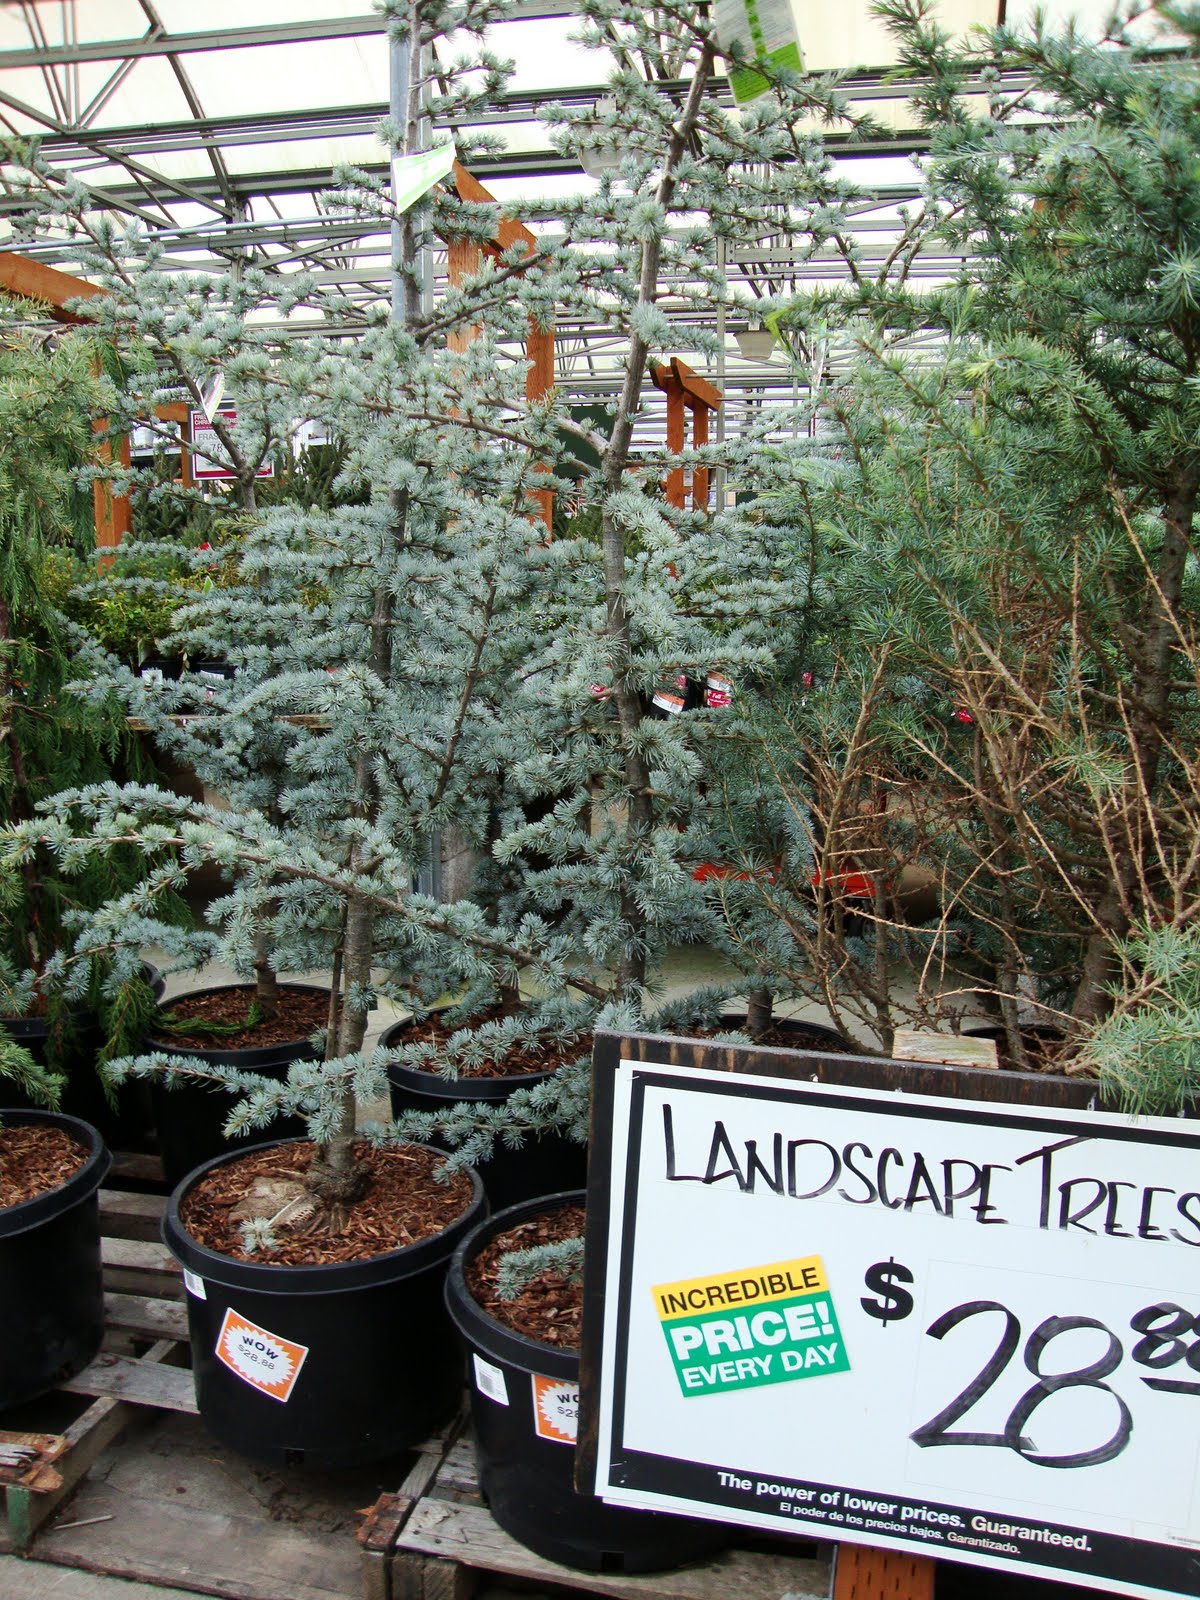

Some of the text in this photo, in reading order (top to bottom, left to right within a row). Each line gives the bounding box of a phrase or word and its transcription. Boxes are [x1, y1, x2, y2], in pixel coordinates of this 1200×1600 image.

[663, 1103, 1200, 1247] LANDSCAPE TREES
[660, 1266, 820, 1314] INCREDIBLE
[242, 1335, 279, 1360] WOW
[669, 1301, 835, 1361] PRICE!
[238, 1344, 275, 1370] $28.88
[682, 1342, 838, 1388] EVERY DAY
[859, 1256, 1200, 1469] $ 28 8
[557, 1394, 579, 1403] WO
[717, 1471, 1092, 1551] The power of lower prices. Guaranteed.
[780, 1502, 1021, 1554] El poder de los precios bajos. Garantizado.
